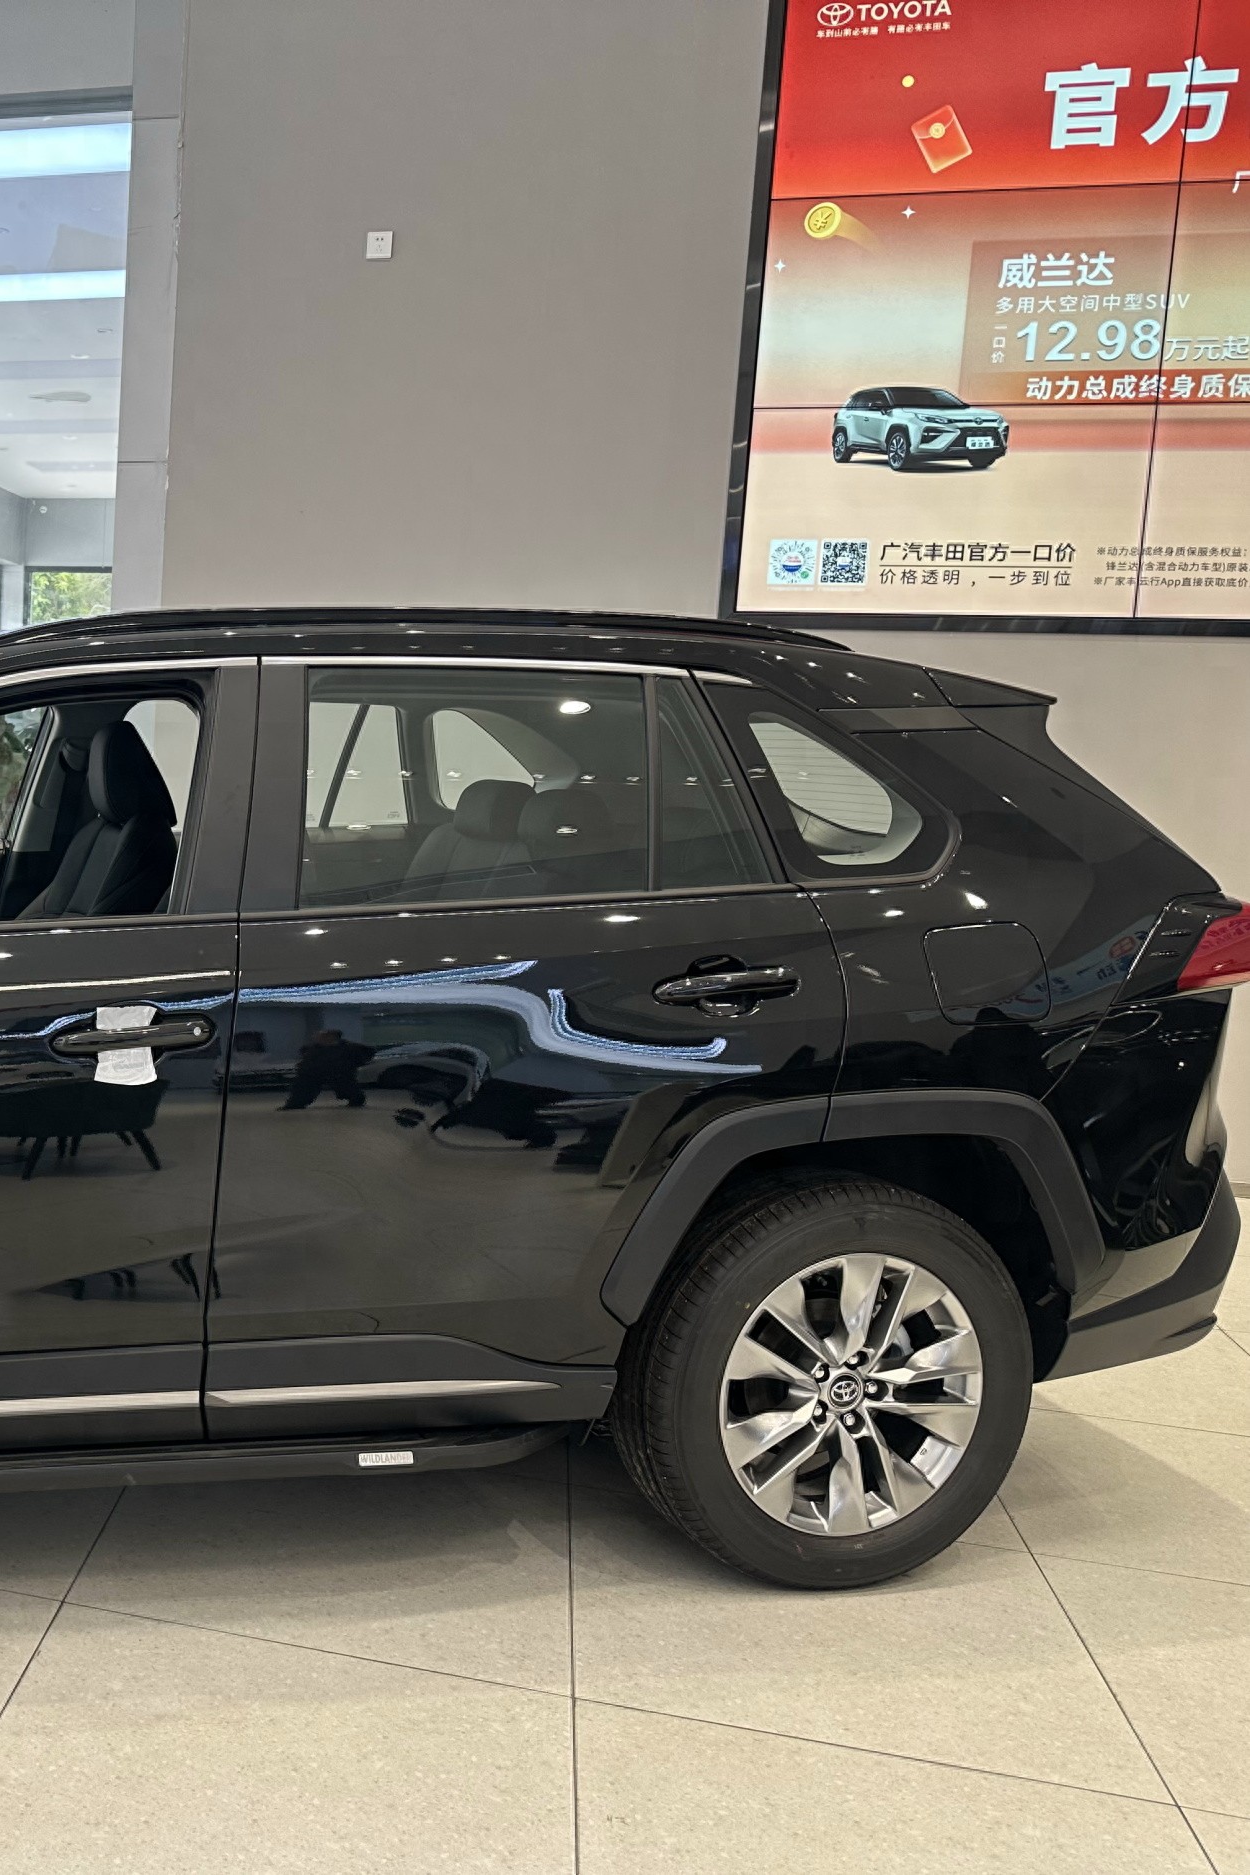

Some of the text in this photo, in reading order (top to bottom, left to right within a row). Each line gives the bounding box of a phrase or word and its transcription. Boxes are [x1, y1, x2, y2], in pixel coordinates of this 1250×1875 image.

[857, 0, 952, 21] TOYOTA
[1044, 55, 1240, 150] 官方
[998, 250, 1115, 289] 威兰达
[995, 293, 1191, 315] 多用大空间中型SUV
[1026, 373, 1250, 400] 动力总成终身质保
[880, 542, 1076, 563] 广汽丰田官方一口价
